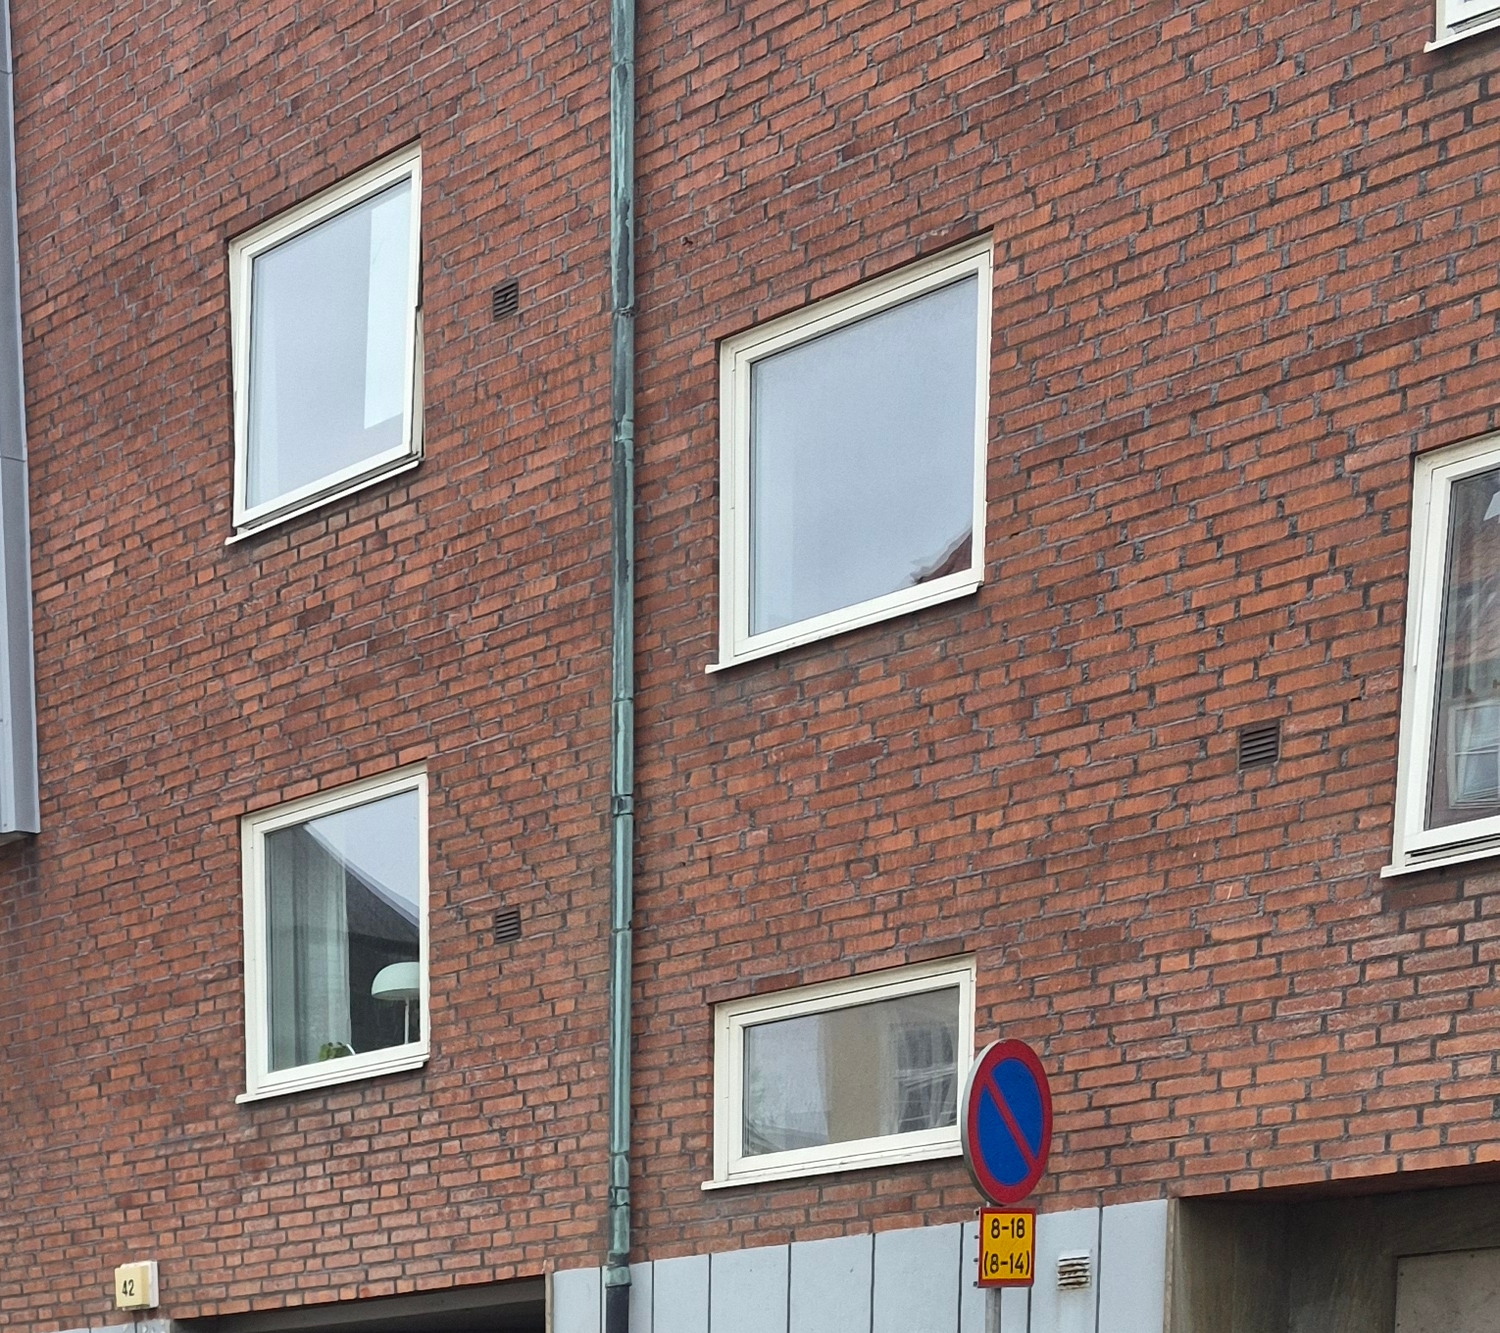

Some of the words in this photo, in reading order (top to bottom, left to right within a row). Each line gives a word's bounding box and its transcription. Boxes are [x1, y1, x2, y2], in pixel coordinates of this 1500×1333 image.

[990, 1217, 1025, 1239] 8-18
[984, 1250, 1030, 1277] (8-14)
[122, 1279, 135, 1297] 42
